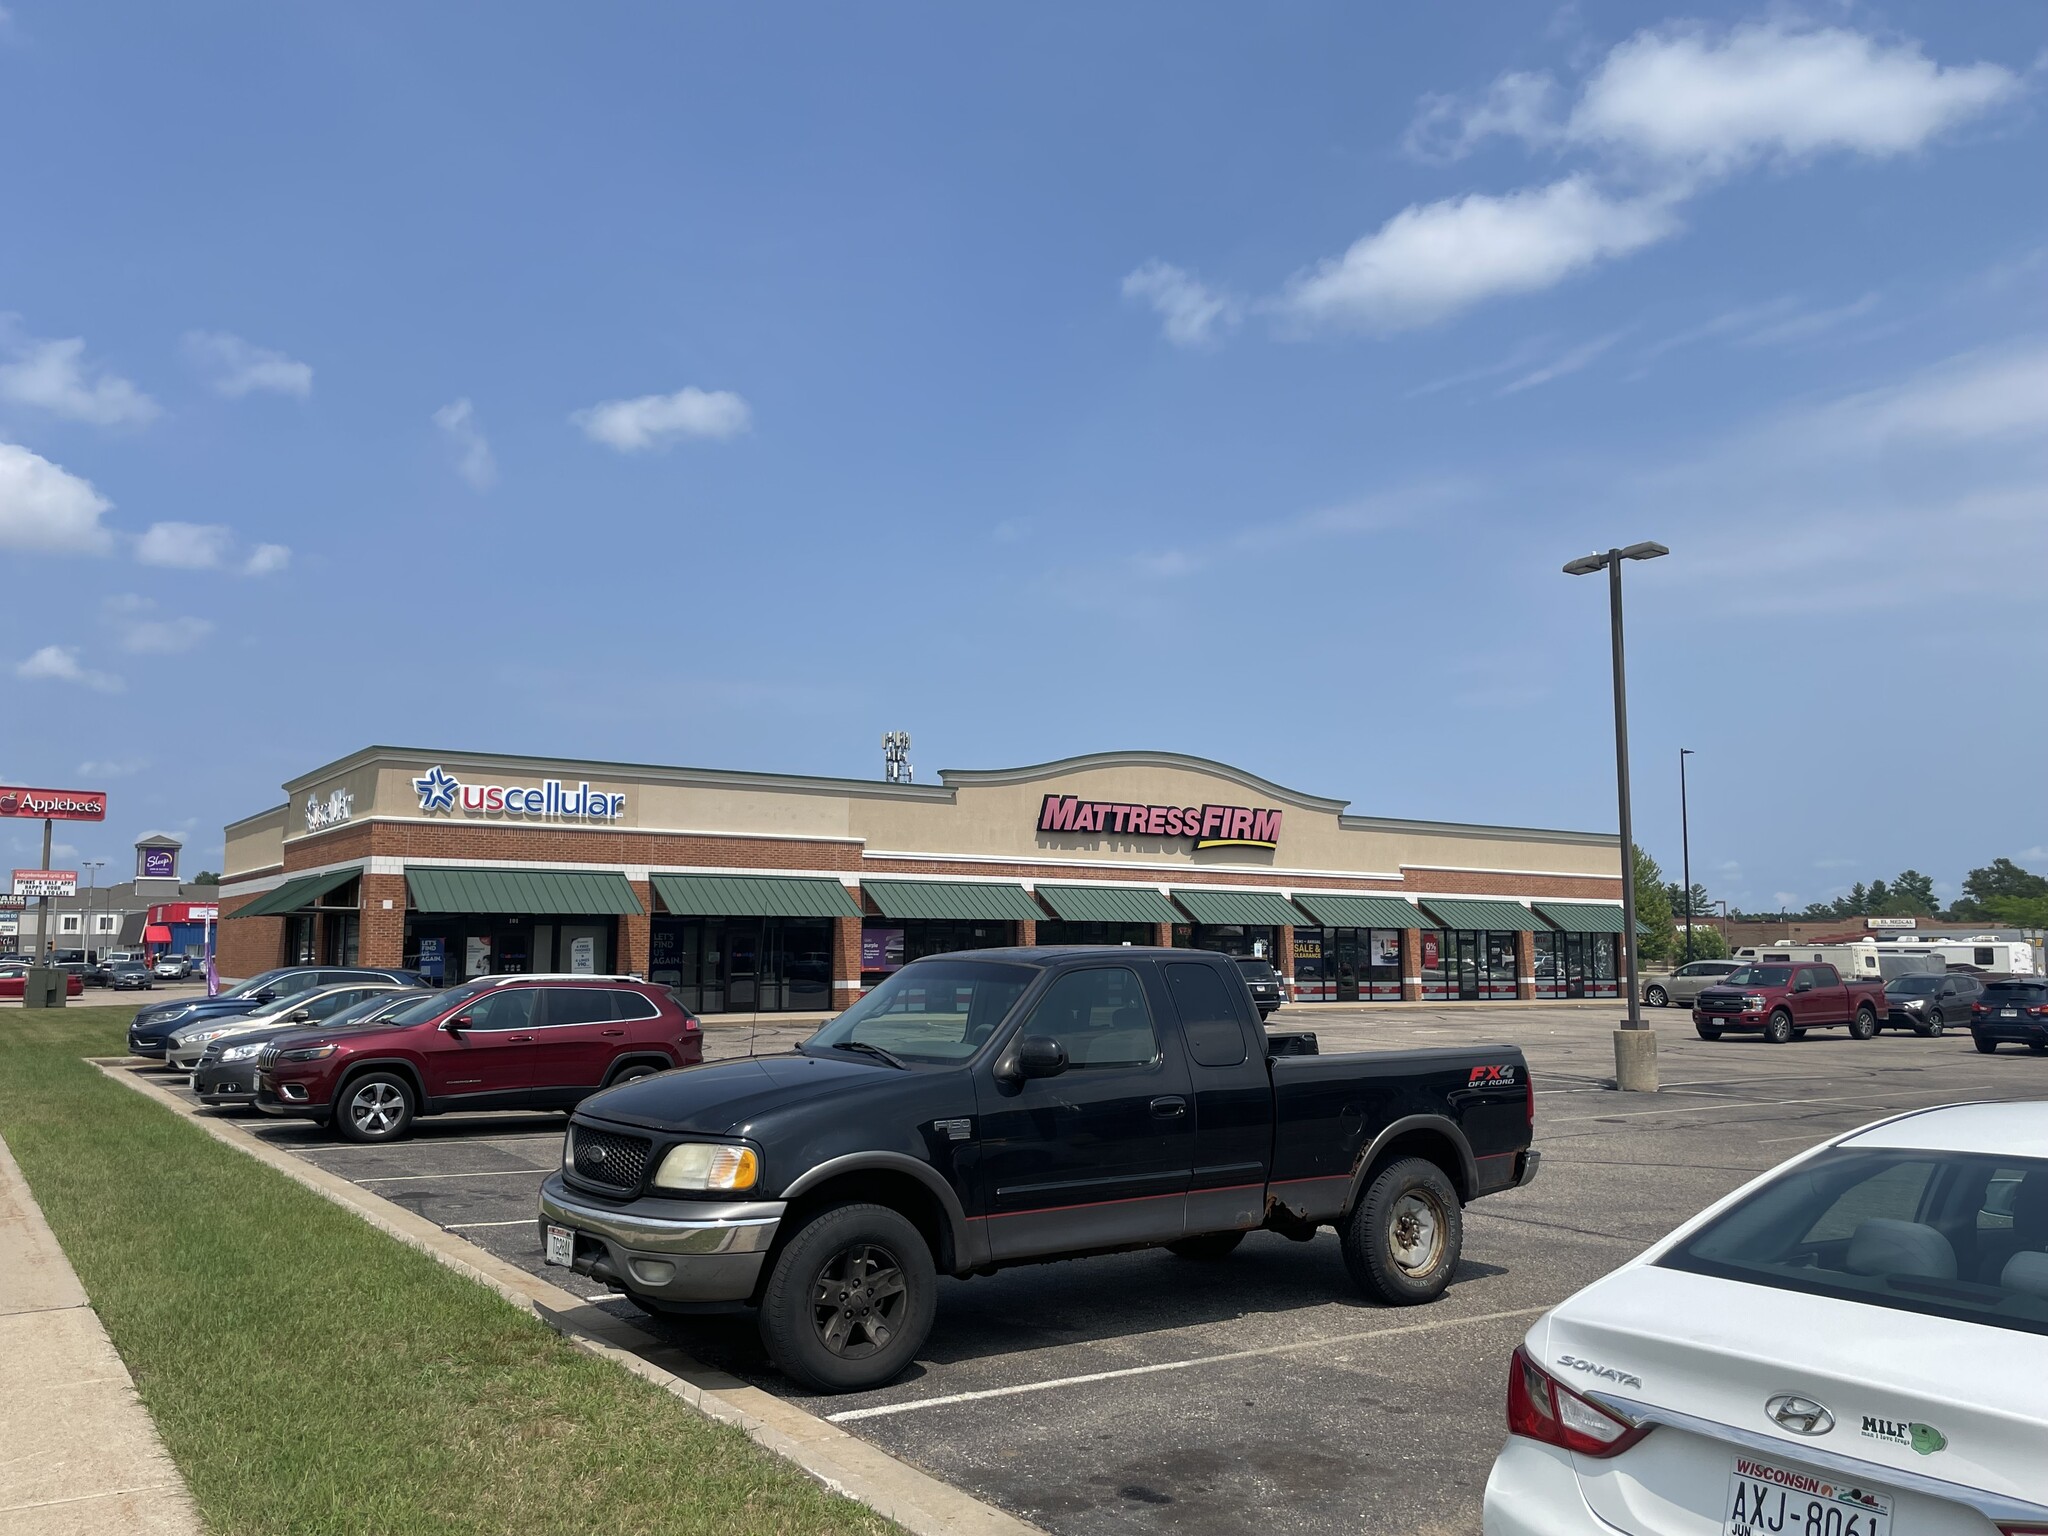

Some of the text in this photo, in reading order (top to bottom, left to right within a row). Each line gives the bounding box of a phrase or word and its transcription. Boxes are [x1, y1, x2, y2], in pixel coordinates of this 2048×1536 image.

[20, 793, 102, 812] Applebee's
[464, 781, 625, 817] uscellular
[653, 933, 675, 941] LET'S
[653, 941, 674, 949] FIND
[1294, 944, 1321, 953] SALE &
[1425, 942, 1436, 951] 0%
[653, 949, 665, 957] US
[652, 957, 682, 965] AGAIN.
[1469, 1064, 1515, 1081] FX4
[1468, 1078, 1515, 1088] OFF ROAD
[1557, 1355, 1642, 1390] SONATA
[1880, 1434, 1894, 1442] love
[1737, 1459, 1820, 1494] WISCONSIN
